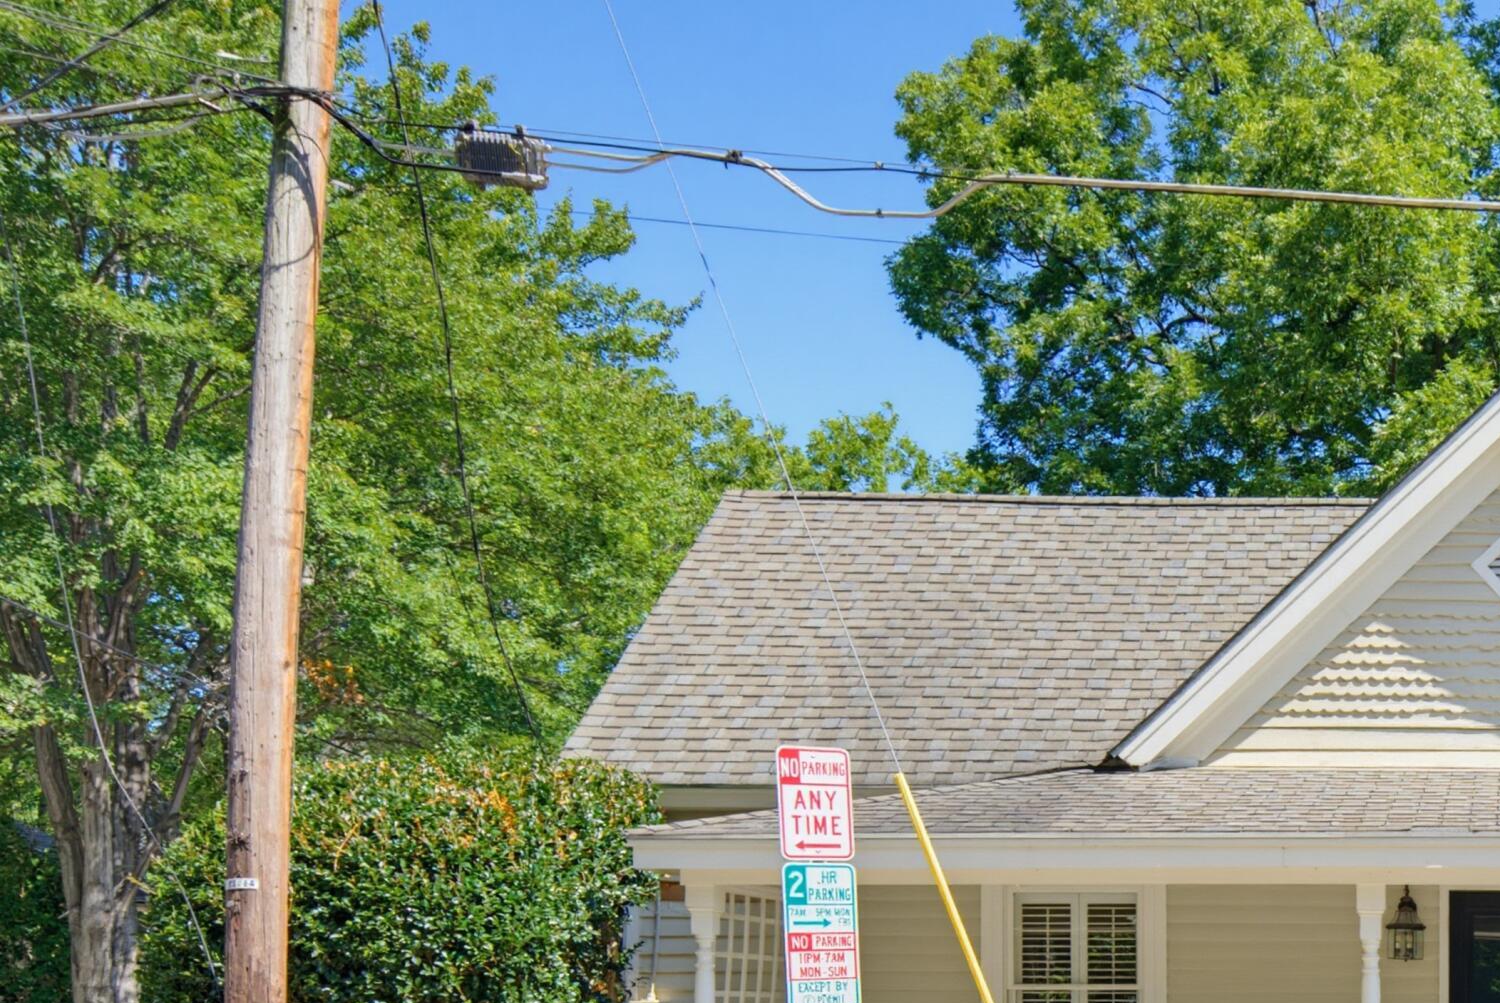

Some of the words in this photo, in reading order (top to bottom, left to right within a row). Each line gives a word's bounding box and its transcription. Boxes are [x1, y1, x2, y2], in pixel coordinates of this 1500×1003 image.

[781, 757, 800, 778] NO
[802, 761, 846, 777] PARKING
[794, 790, 837, 811] ANY
[791, 814, 842, 836] TIME
[788, 871, 805, 898] 2
[821, 870, 838, 884] HR
[808, 887, 851, 901] PARKING
[791, 935, 809, 950] NO
[815, 935, 852, 947] PARKING
[798, 981, 831, 993] EXCEPT
[835, 980, 848, 991] BY
